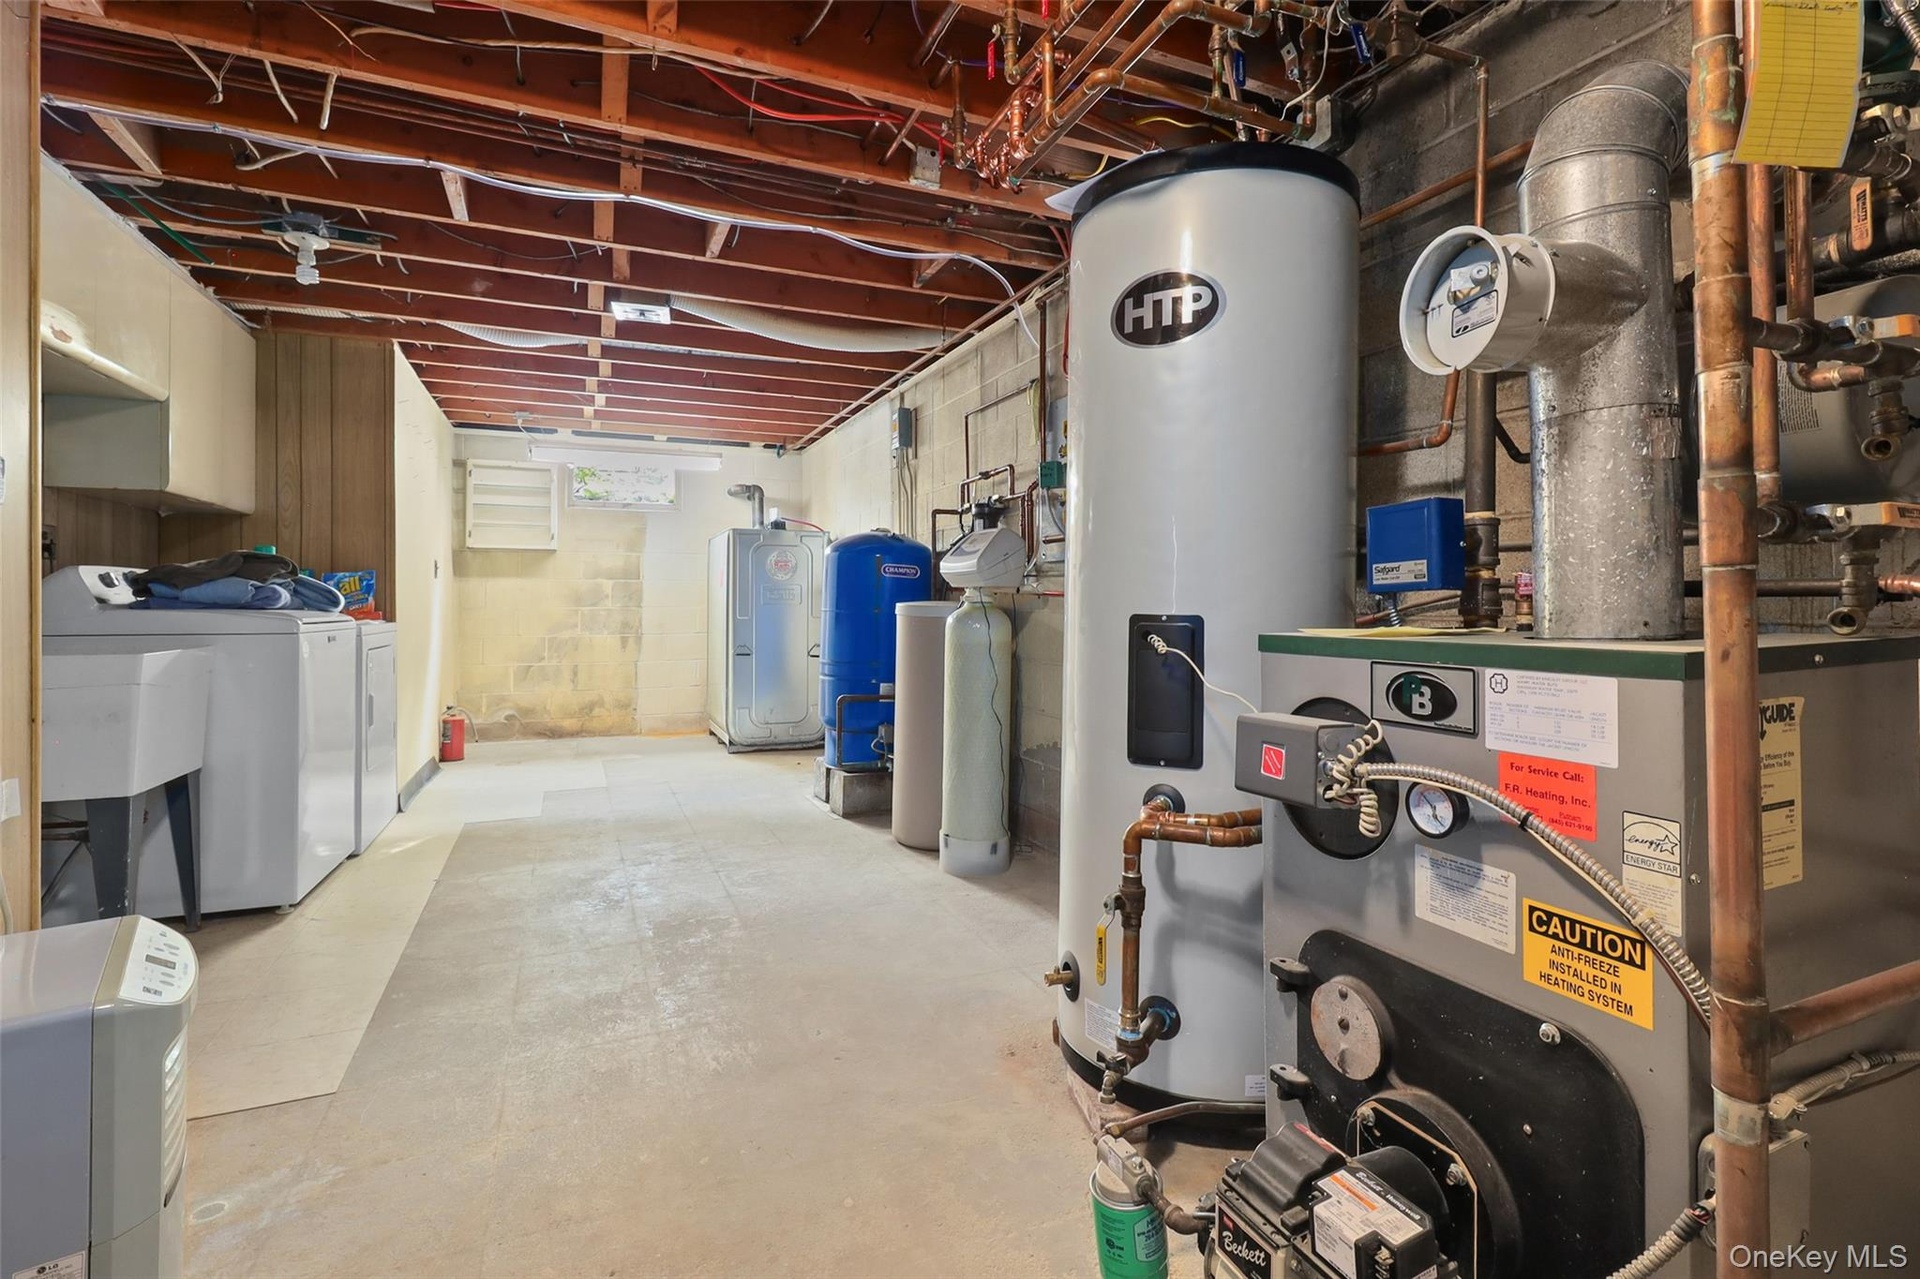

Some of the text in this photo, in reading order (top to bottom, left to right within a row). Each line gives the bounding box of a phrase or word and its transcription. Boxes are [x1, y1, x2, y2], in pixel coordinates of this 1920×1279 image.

[1124, 285, 1213, 334] HTP
[339, 576, 361, 596] all
[885, 566, 917, 574] CHAMPION
[1510, 762, 1585, 783] For Service Call:
[1504, 783, 1591, 808] F.R. Heating, Inc.
[1625, 854, 1678, 874] ENERGY STAR
[1532, 910, 1642, 966] CAUTION
[1549, 958, 1622, 996] INSTALLED IN
[1550, 944, 1620, 978] ANTI-FREEZE
[1539, 971, 1633, 1017] HEATING SYSTEM
[1222, 1230, 1267, 1267] Beckett
